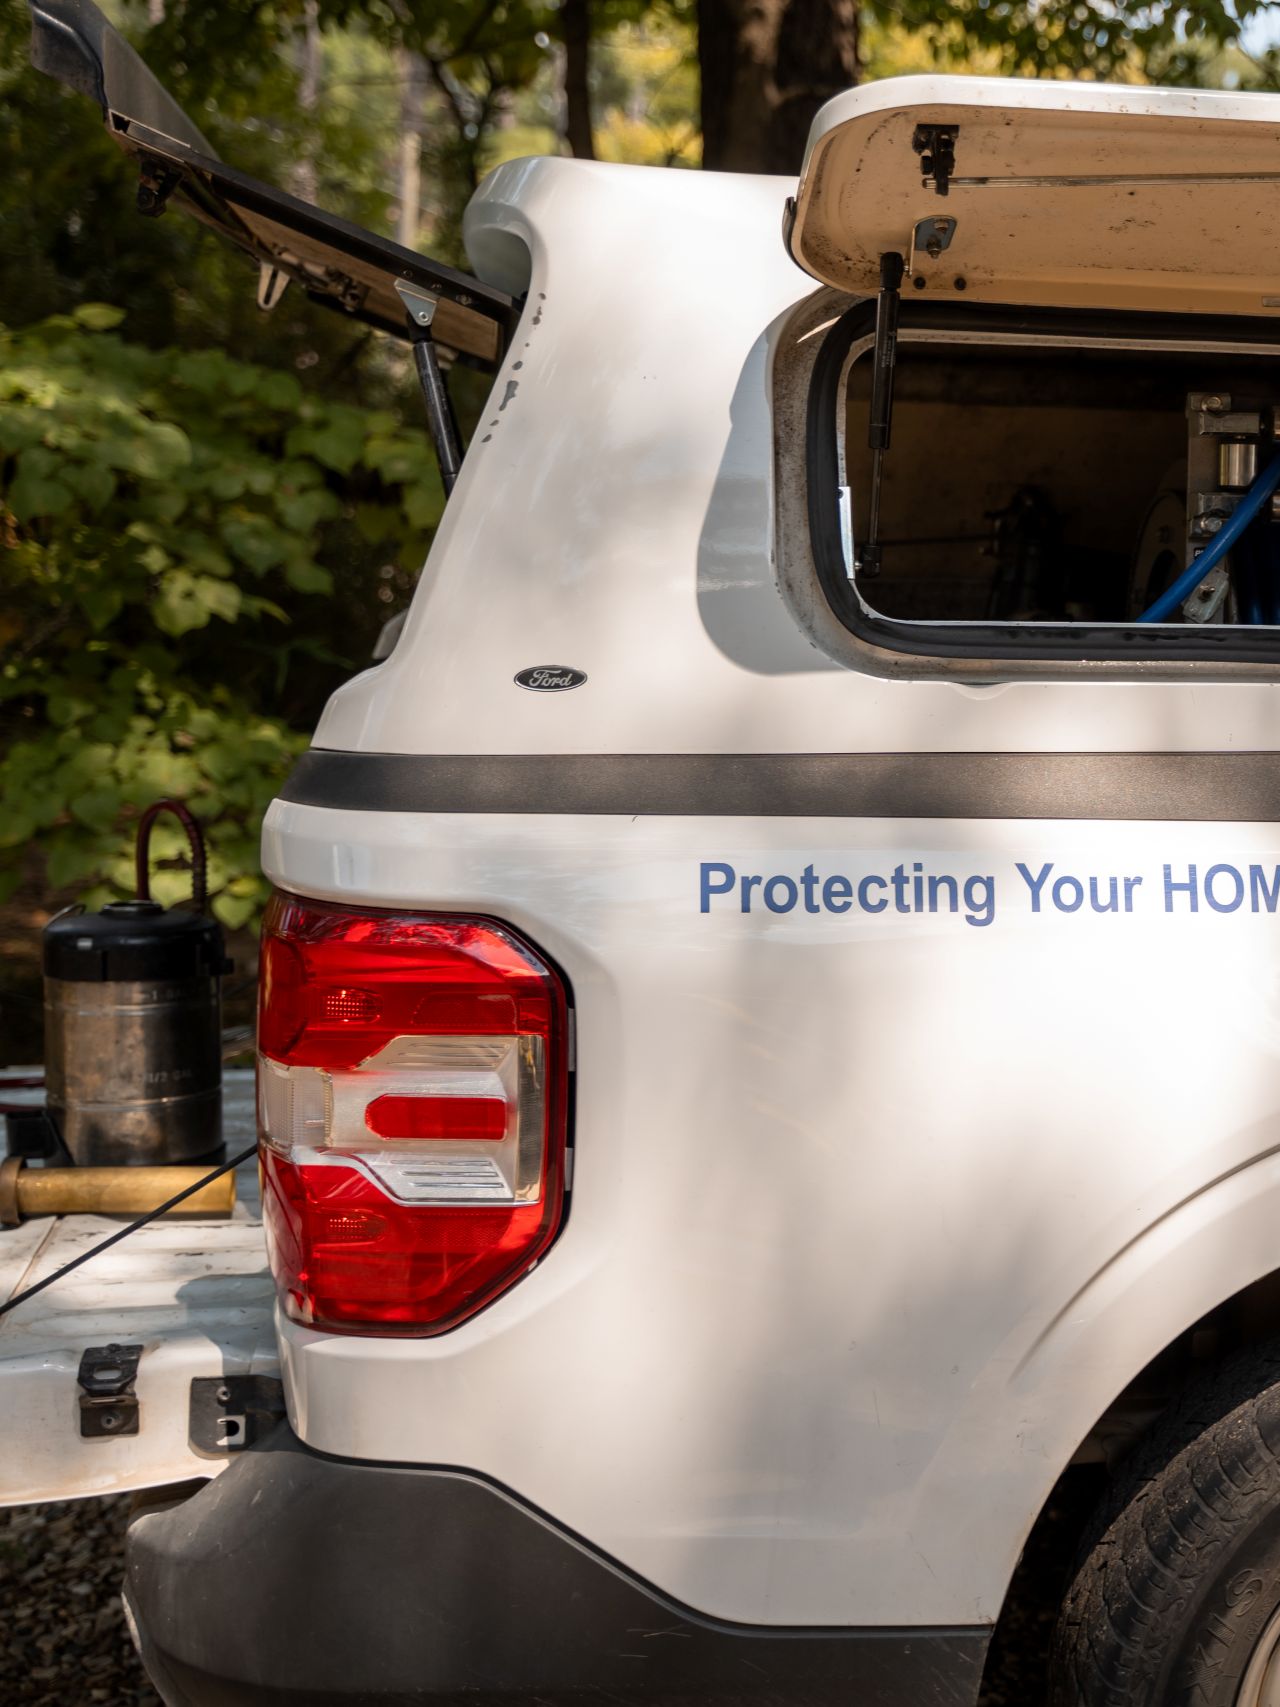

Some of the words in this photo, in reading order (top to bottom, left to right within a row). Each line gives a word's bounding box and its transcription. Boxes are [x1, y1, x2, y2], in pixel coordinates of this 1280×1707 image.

[528, 669, 573, 687] Ford
[699, 862, 995, 927] Protecting
[1016, 863, 1143, 913] Your
